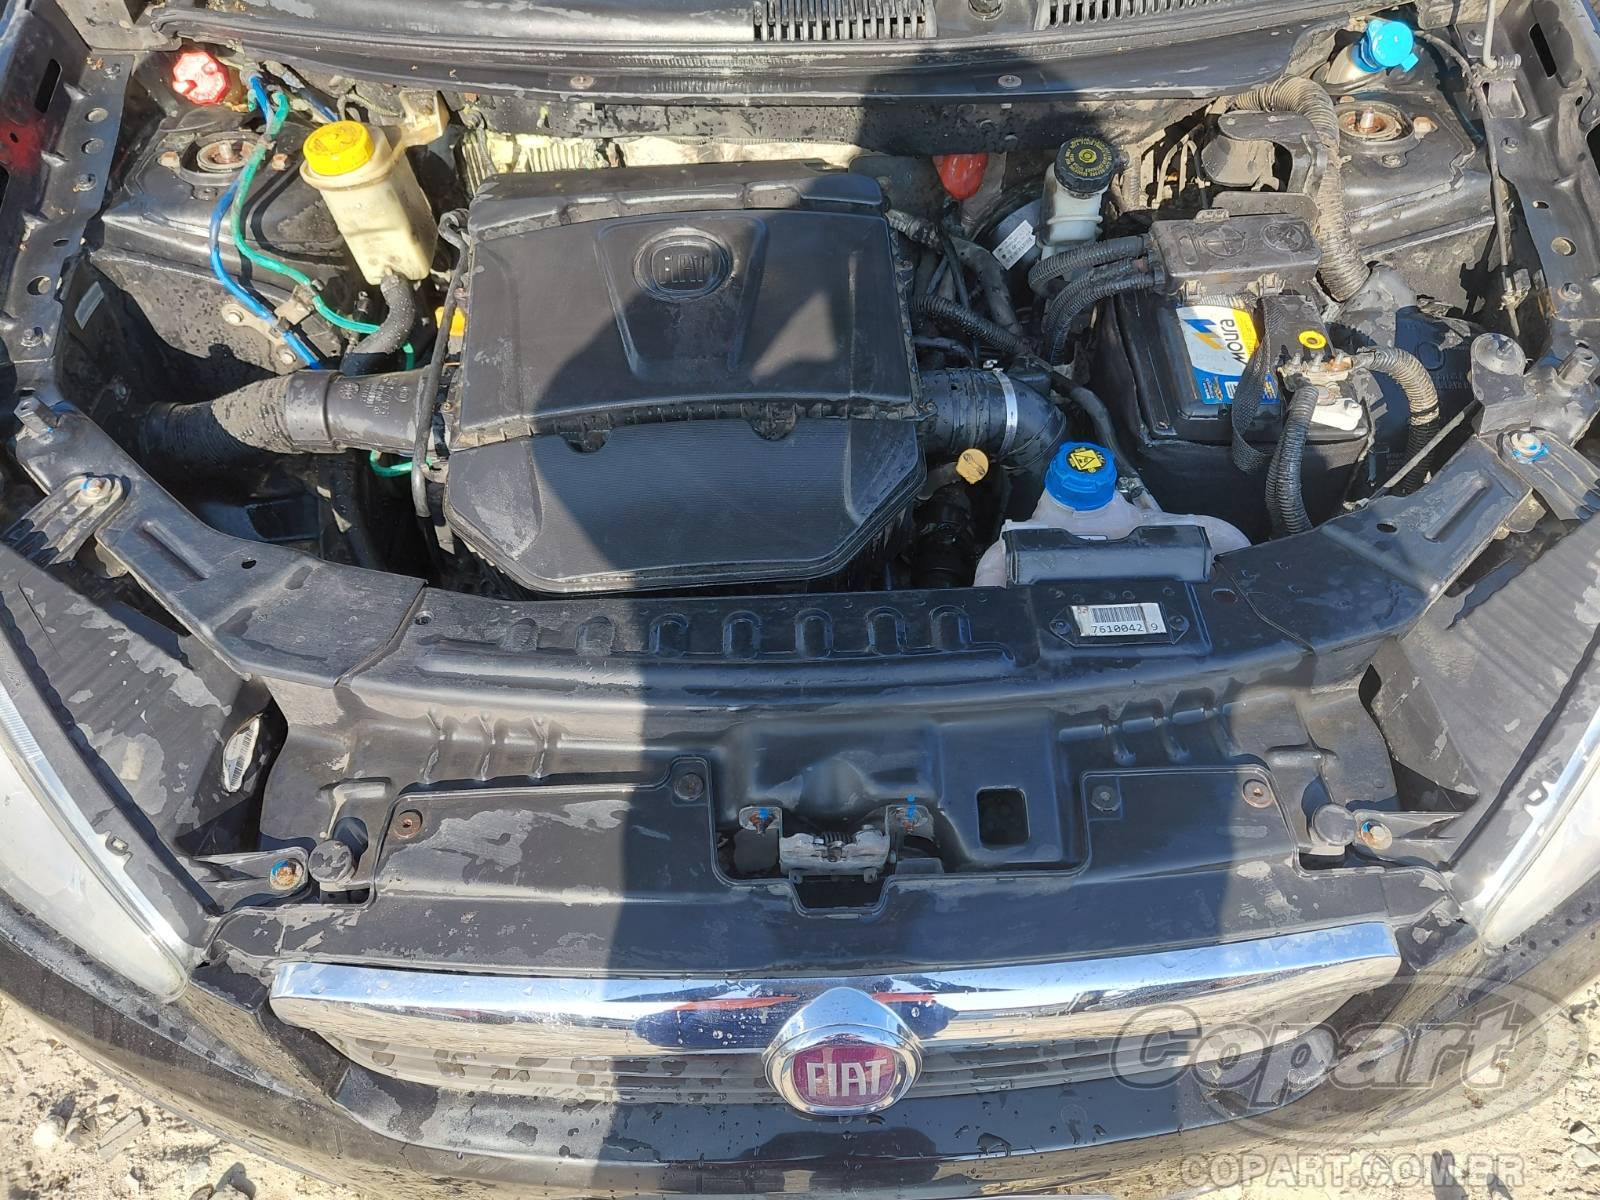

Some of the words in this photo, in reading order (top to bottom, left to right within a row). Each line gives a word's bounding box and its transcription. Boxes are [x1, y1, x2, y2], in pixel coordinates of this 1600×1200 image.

[658, 253, 708, 285] FIAT
[1151, 622, 1158, 632] 9
[806, 1058, 887, 1097] FIAT
